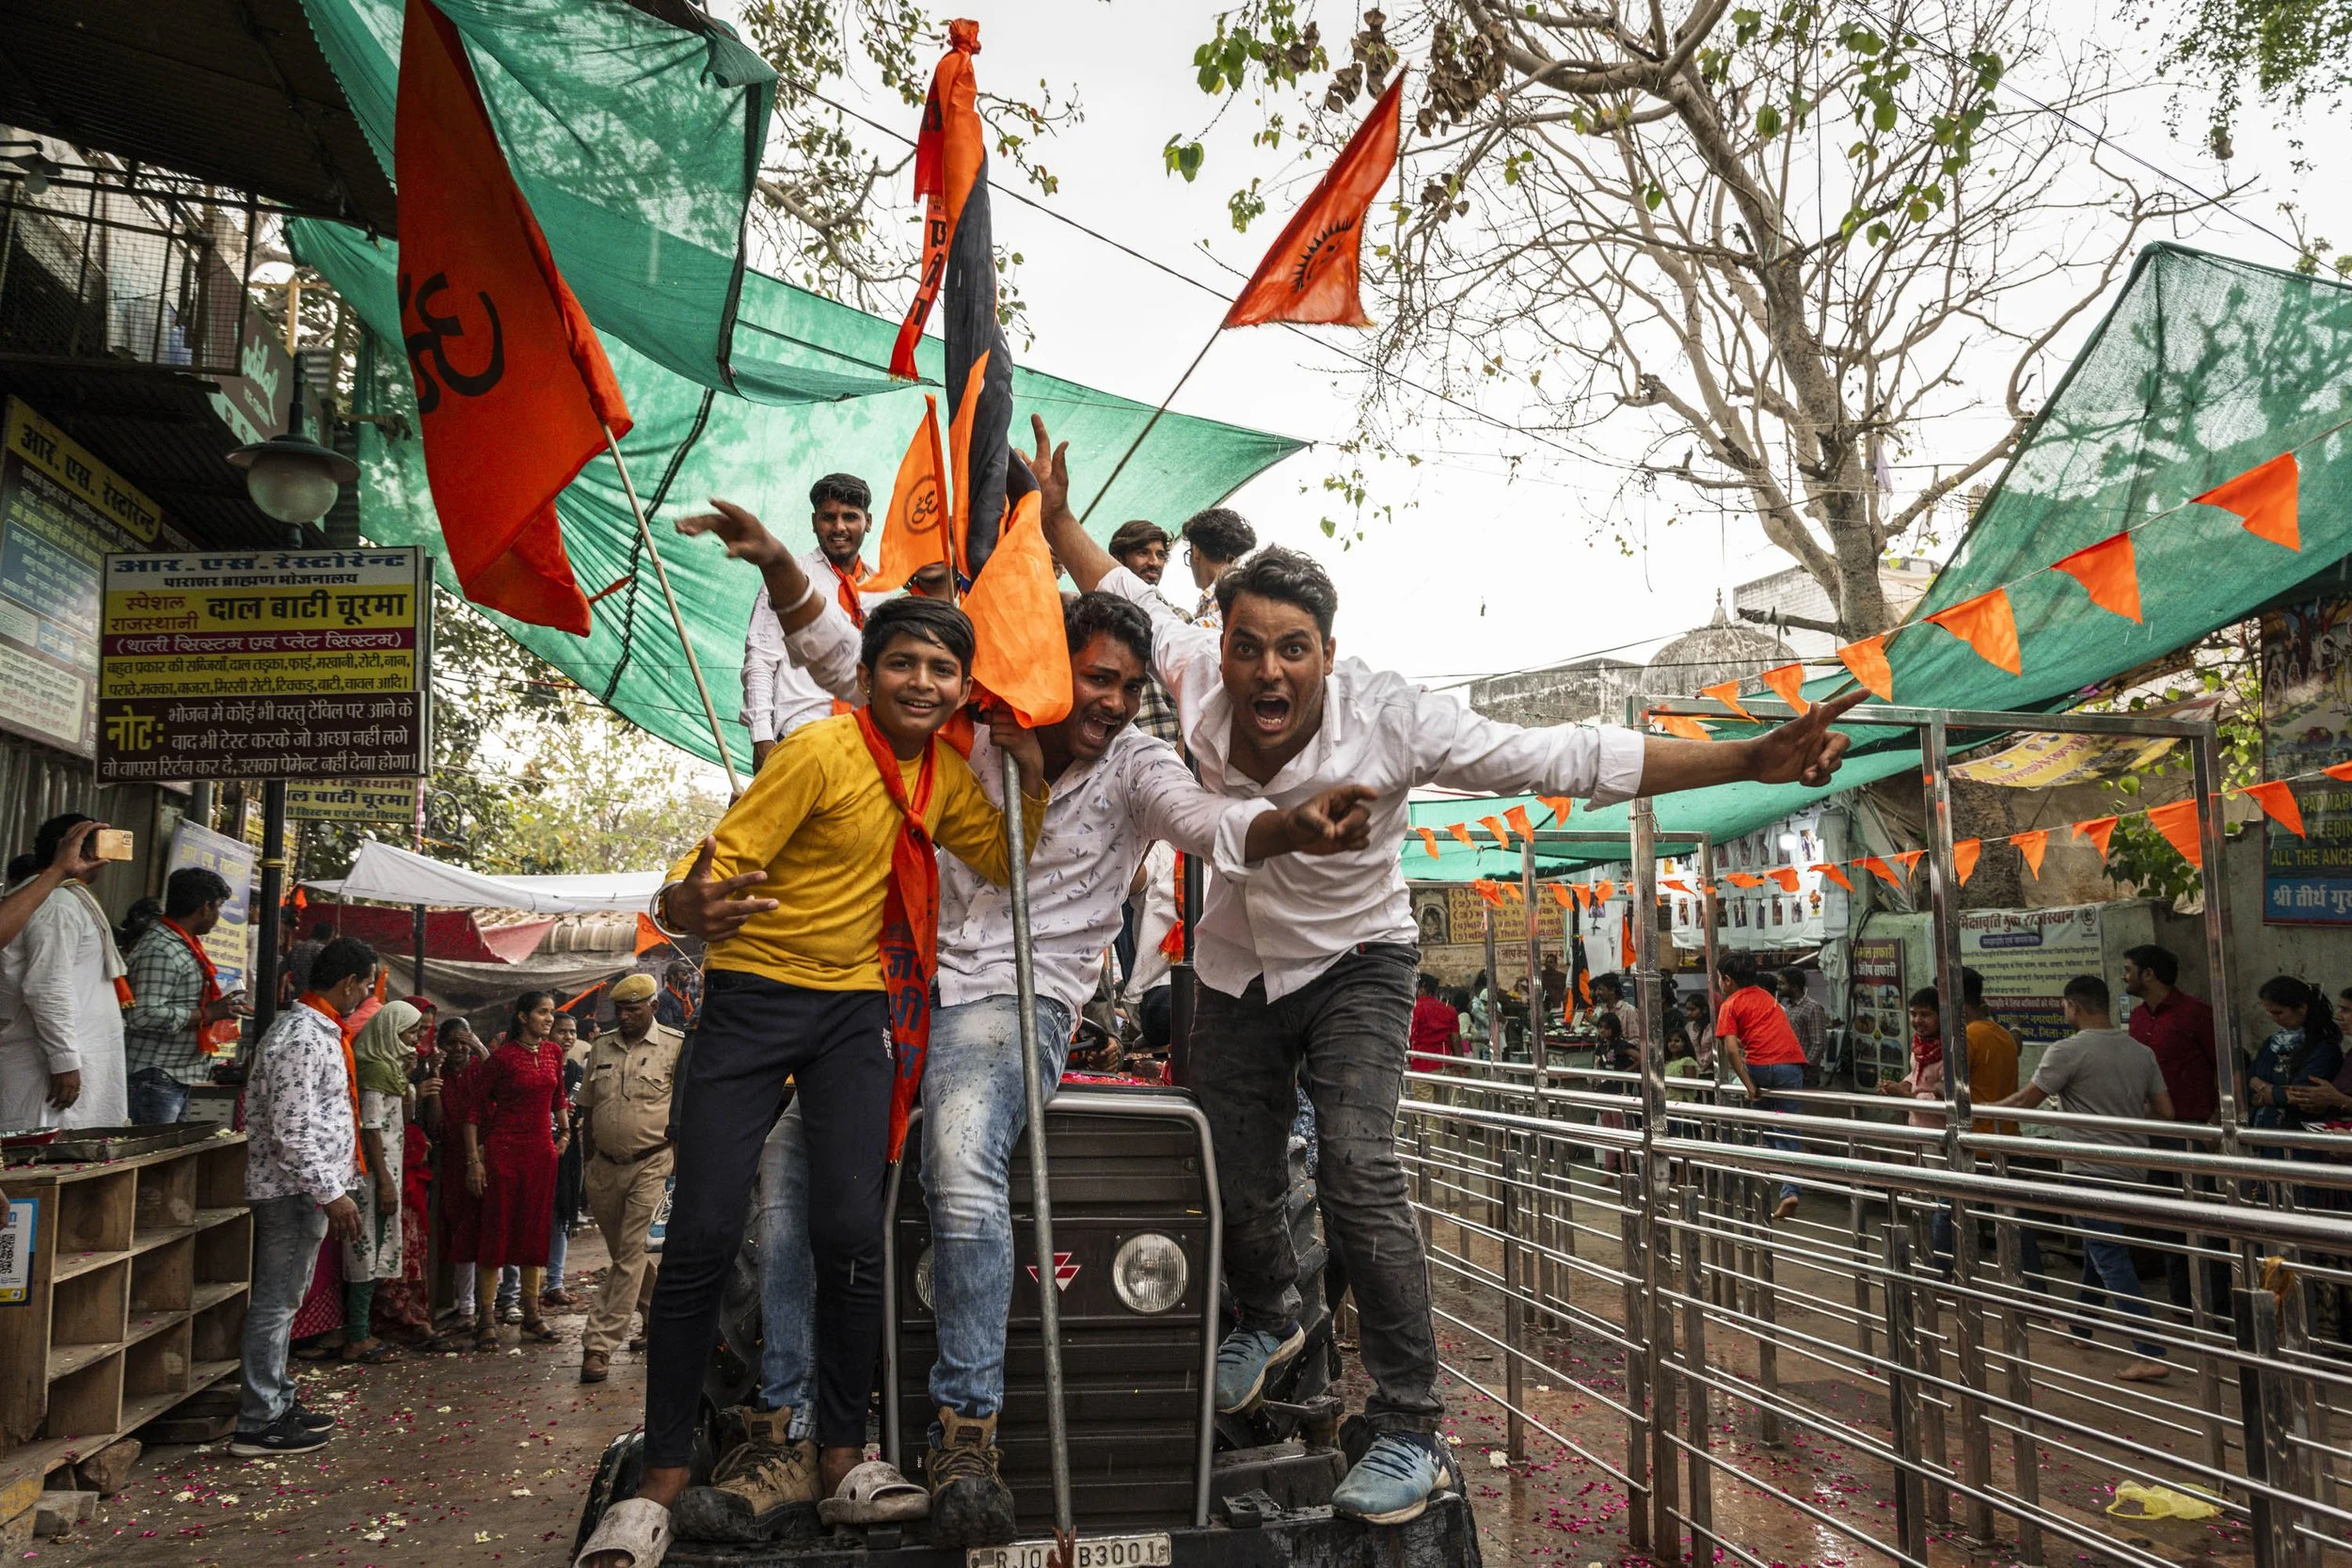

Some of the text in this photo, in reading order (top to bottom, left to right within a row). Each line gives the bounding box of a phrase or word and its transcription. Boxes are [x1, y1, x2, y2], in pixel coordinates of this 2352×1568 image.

[278, 572, 358, 585] भोजनालय
[125, 592, 185, 610] स्पेशल
[206, 589, 407, 626] दाल बाटी चूरमा
[111, 611, 199, 631] राजस्थानी
[174, 634, 245, 652] सिस्टम
[281, 631, 322, 649] प्लेट
[167, 657, 183, 673] की
[168, 703, 209, 722] भोजन
[212, 700, 224, 721] में
[226, 700, 256, 724] कोई
[258, 700, 275, 721] भी
[277, 705, 306, 726] वस्तु
[368, 698, 398, 719] आने
[398, 698, 413, 718] के
[199, 729, 218, 750] भी
[220, 729, 248, 749] टेस्ट
[251, 728, 291, 749] करके
[293, 727, 311, 747] जो
[314, 731, 351, 746] अच्छा
[353, 723, 380, 746] नहीं
[383, 725, 408, 745] लगे
[102, 757, 118, 777] वो
[119, 761, 156, 776] वापस
[196, 759, 219, 775] कर
[238, 758, 278, 773] उसका
[280, 752, 319, 772] पेमेन्ट
[321, 750, 347, 771] नहीं
[349, 751, 376, 770] देना
[2302, 792, 2352, 813] PADMAP
[2271, 848, 2292, 866] ALL
[2295, 848, 2318, 866] THE
